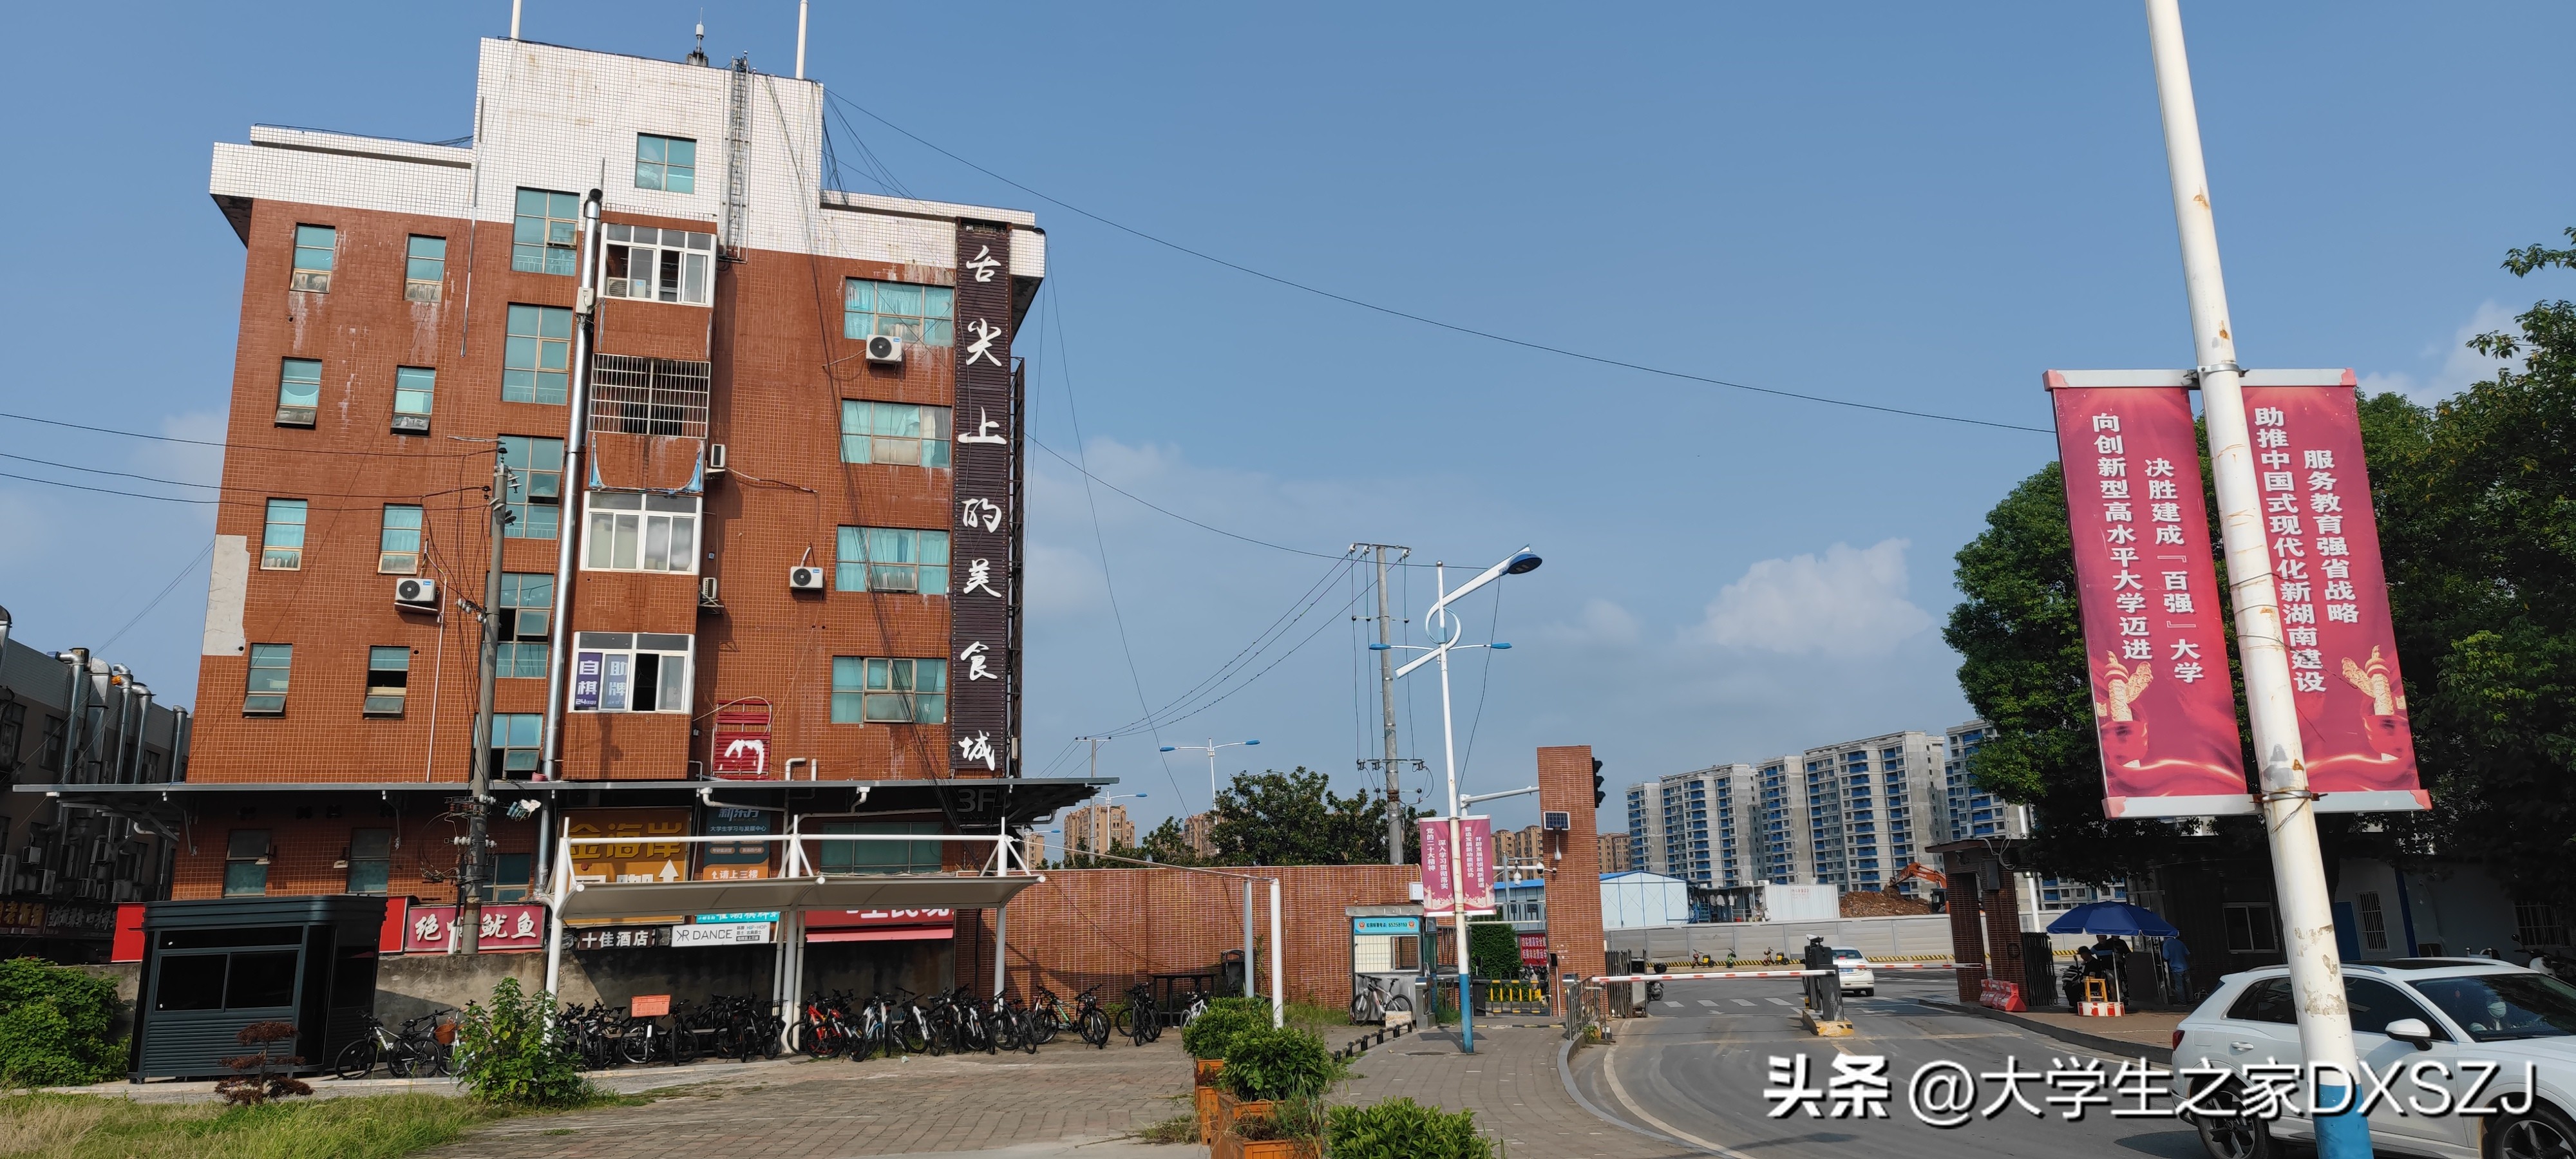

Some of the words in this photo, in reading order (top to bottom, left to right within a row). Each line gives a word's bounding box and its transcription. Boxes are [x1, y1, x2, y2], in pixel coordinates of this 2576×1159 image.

[958, 244, 1006, 771] 舌尖上的美食城
[2092, 413, 2152, 660] 向创新型高水平大学迈进
[2254, 407, 2327, 693] 助推中国式现代化新湖南建设
[2304, 449, 2359, 624] 服务教育强省战略
[2144, 457, 2204, 684] 决胜建成『百强』大学
[718, 807, 759, 822] 新东方
[956, 788, 996, 813] 3F
[569, 822, 682, 860] 金海岸
[1426, 827, 1435, 872] 党的二十大精神
[719, 869, 759, 880] 请上三楼
[1438, 839, 1448, 890] 深入学习贯彻落实
[415, 911, 536, 941] 绝鱿鱼
[692, 929, 733, 940] DANCE
